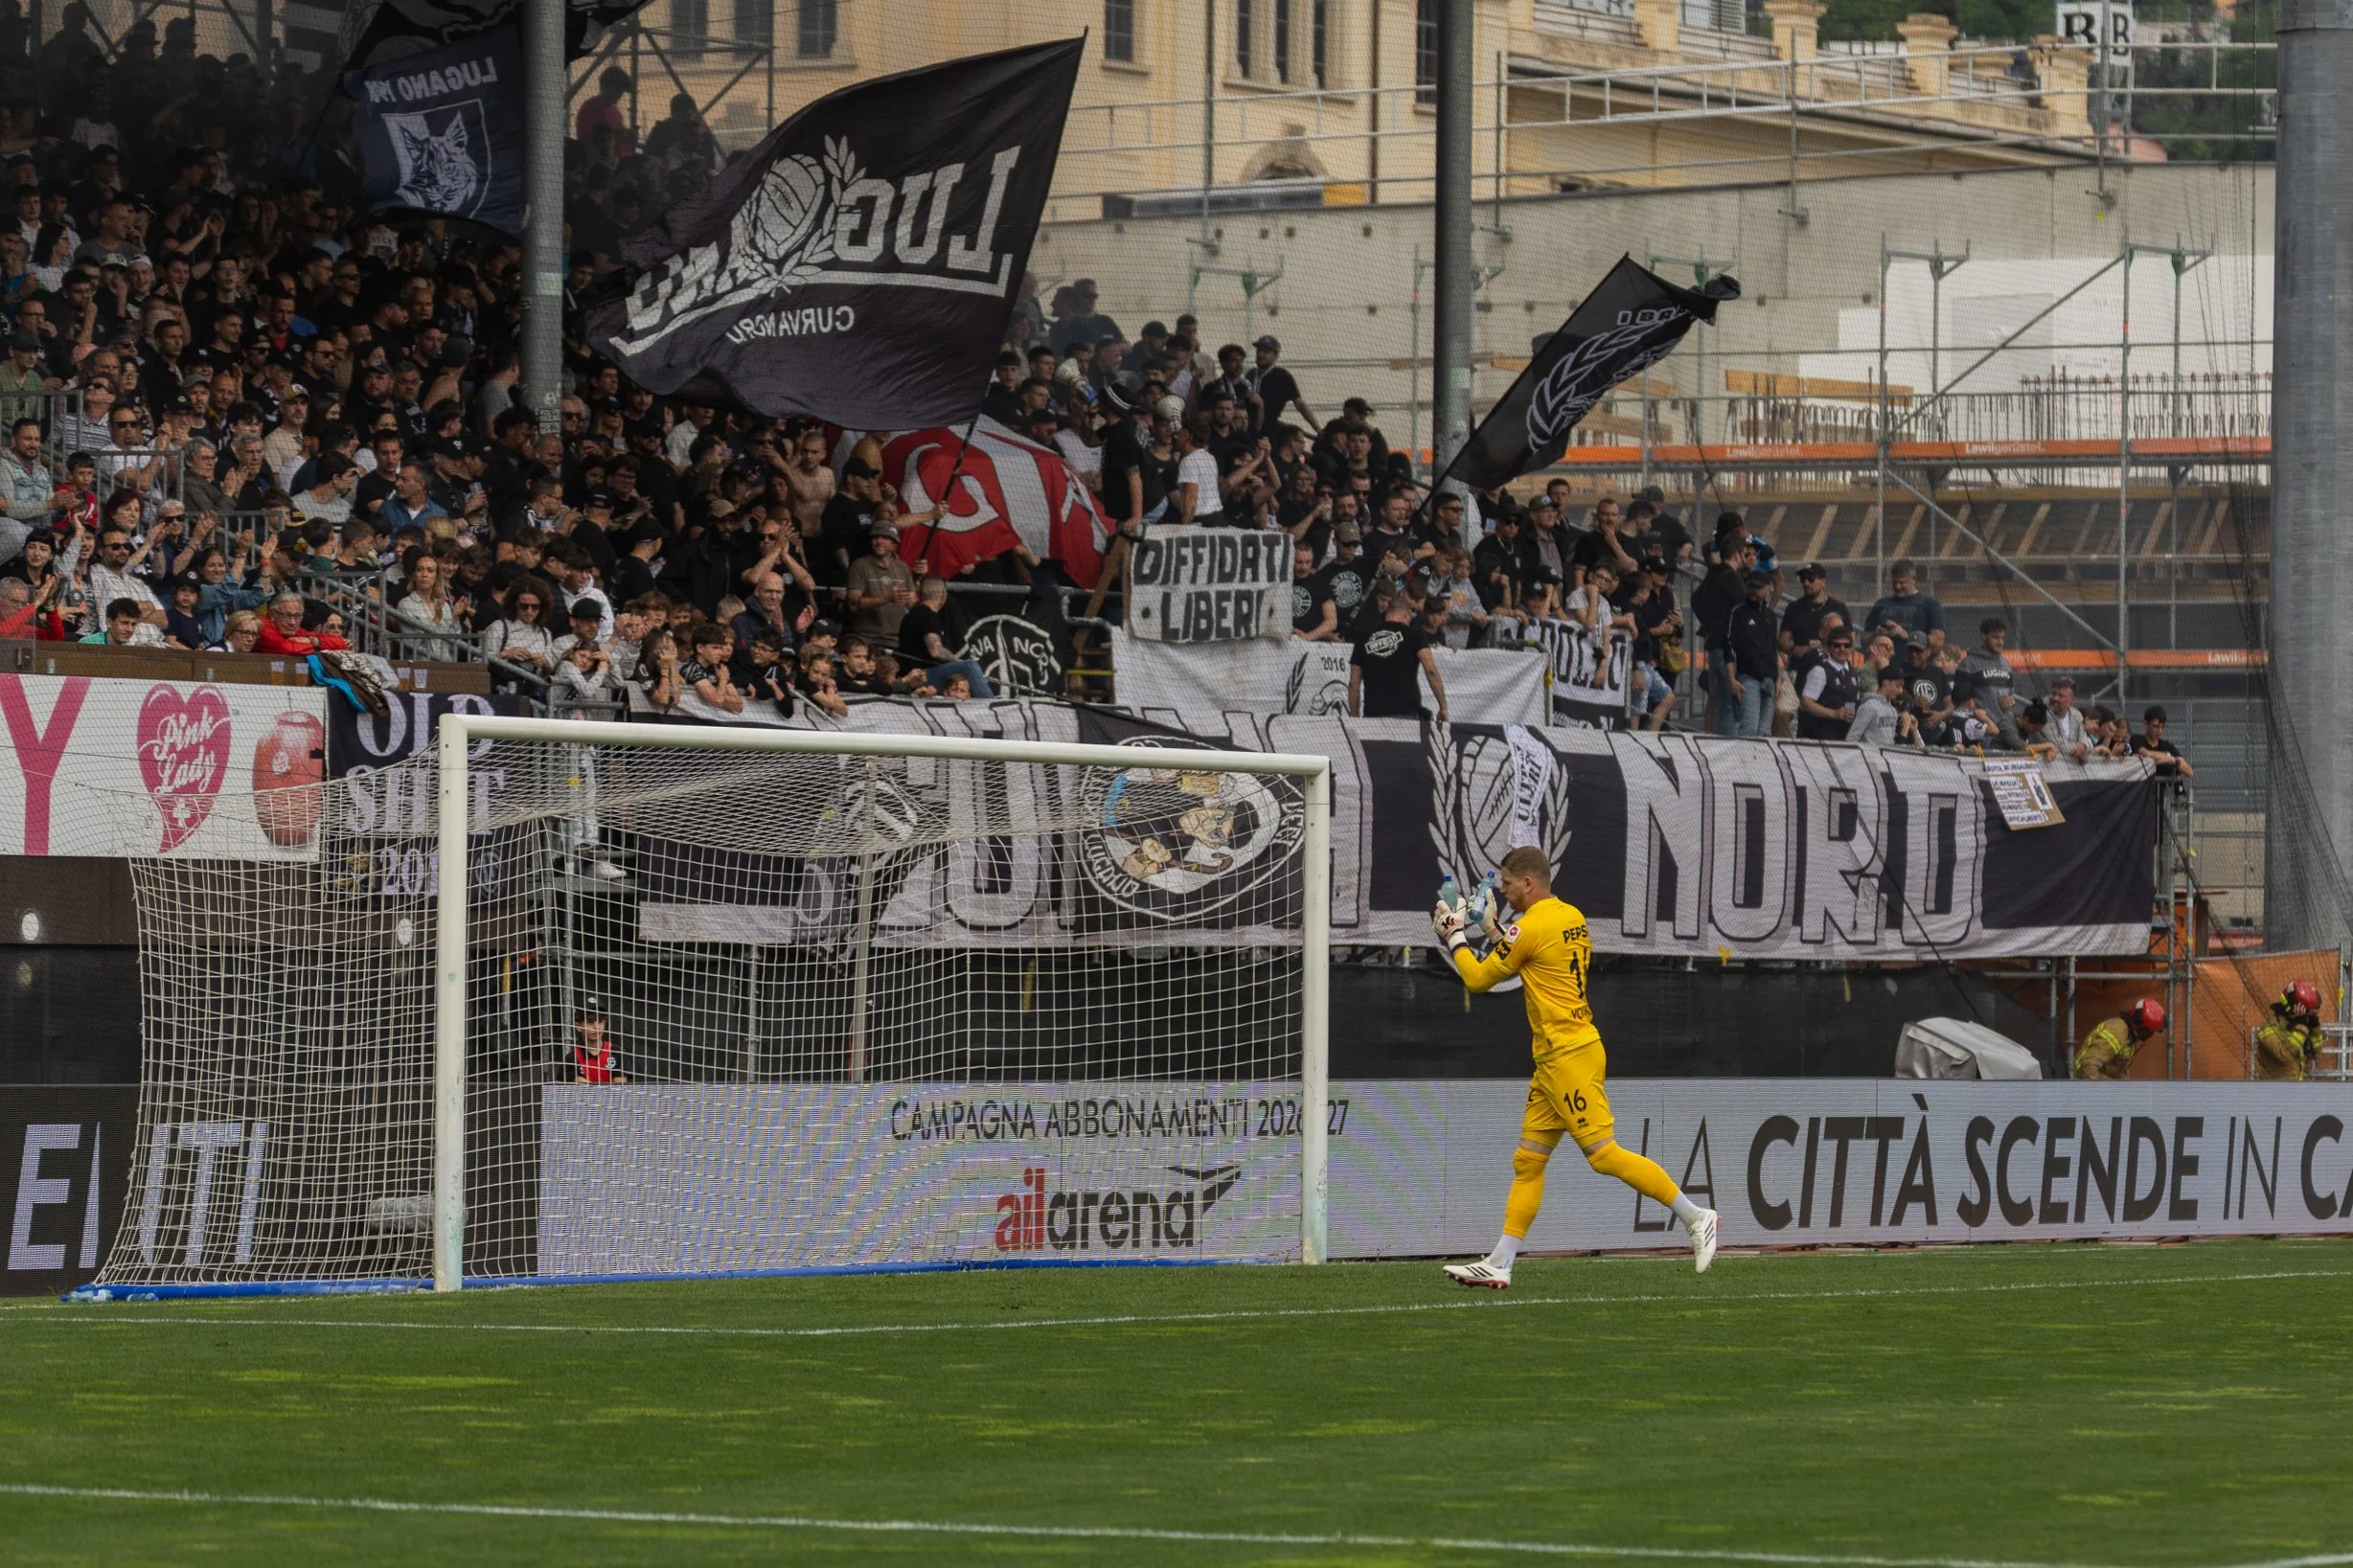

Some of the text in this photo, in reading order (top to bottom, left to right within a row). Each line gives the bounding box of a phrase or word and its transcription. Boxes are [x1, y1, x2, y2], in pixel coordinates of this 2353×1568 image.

[1133, 534, 1291, 586] DIFFIDATI
[1160, 589, 1266, 642] LIBERI
[1320, 655, 1346, 672] 2016
[151, 706, 218, 761] Pink
[0, 673, 91, 854] Y
[153, 745, 217, 796] Lady
[345, 764, 505, 836] SHT
[1606, 731, 1987, 946] NORD
[1563, 923, 1588, 944] PEPS
[891, 1099, 1349, 1141] CAMPAGNA ABBONAMENTI 202627
[1563, 1088, 1588, 1115] 16
[1633, 1117, 1714, 1233] LA
[1747, 1092, 1939, 1231] CITTÀ
[1956, 1115, 2204, 1228] SCENDE
[2223, 1115, 2282, 1220] IN
